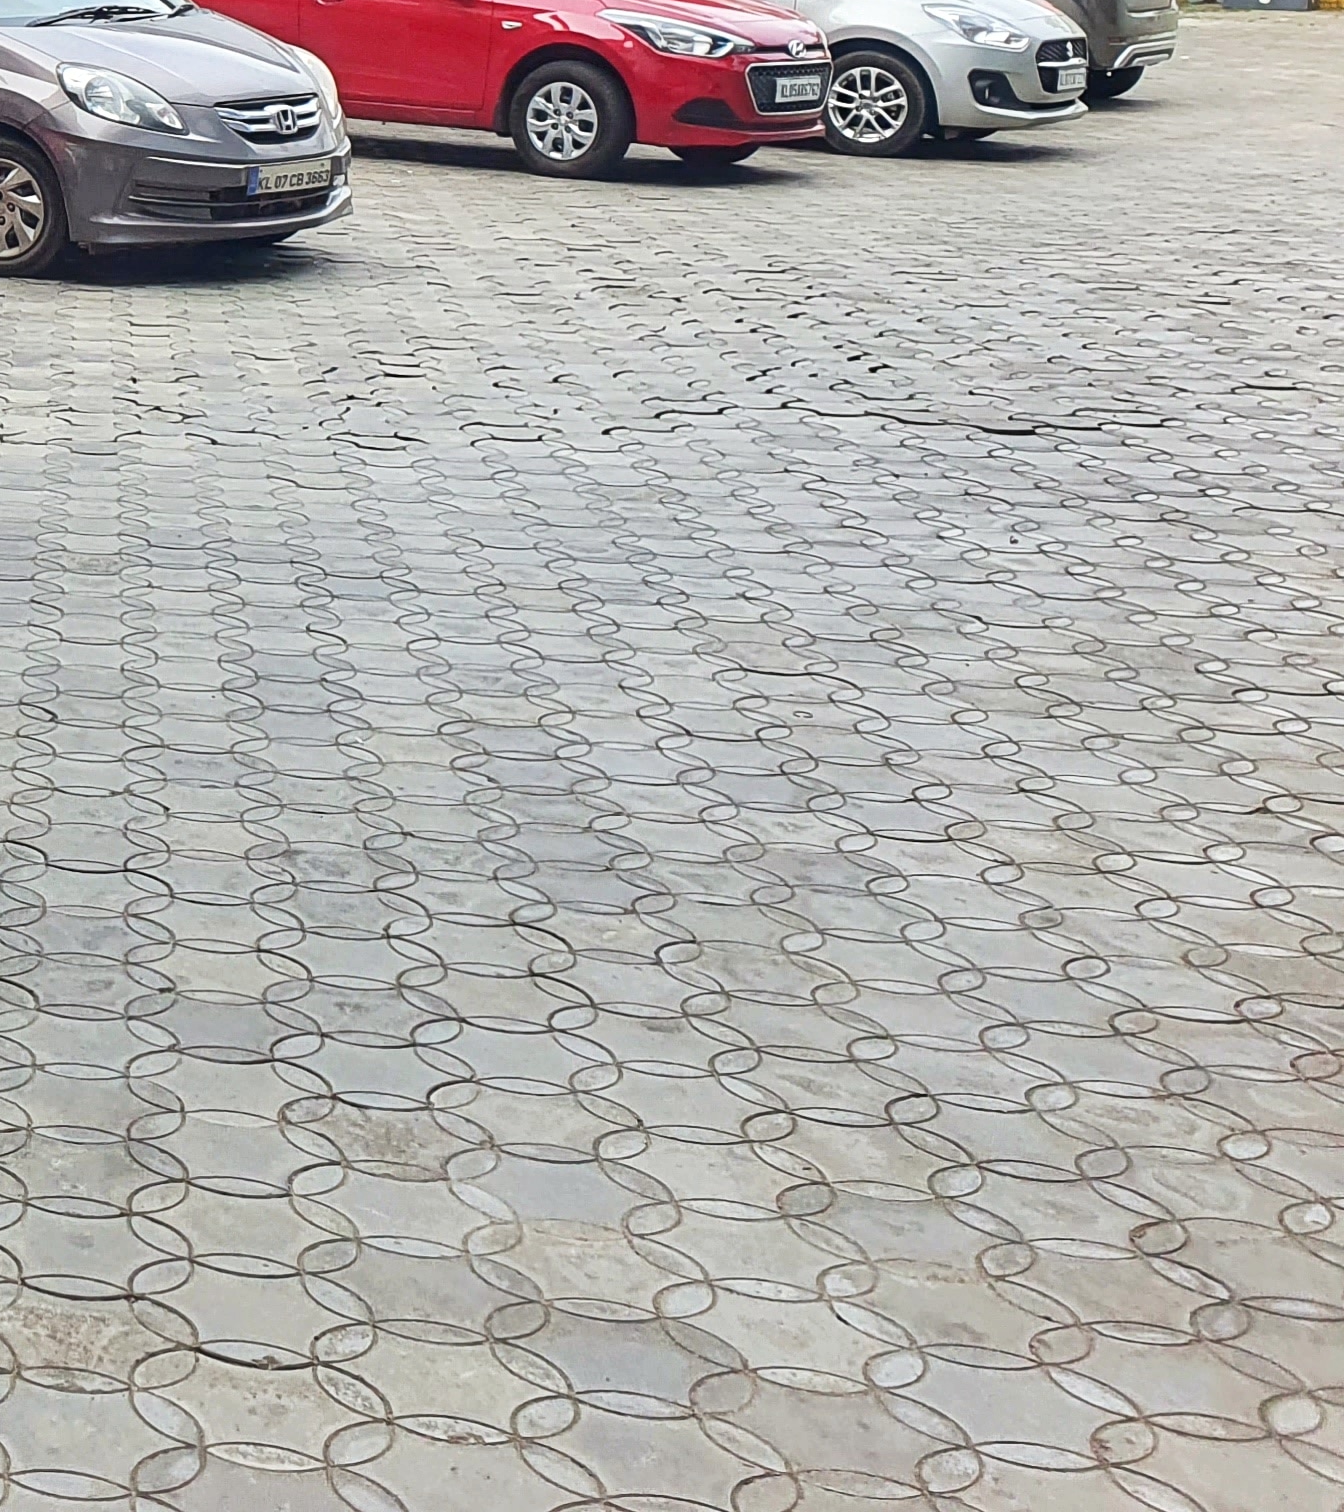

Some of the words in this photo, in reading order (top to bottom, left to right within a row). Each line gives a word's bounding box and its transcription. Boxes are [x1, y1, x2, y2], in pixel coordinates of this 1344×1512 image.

[258, 176, 272, 190] KL
[274, 174, 288, 189] 07
[289, 172, 304, 187] CB
